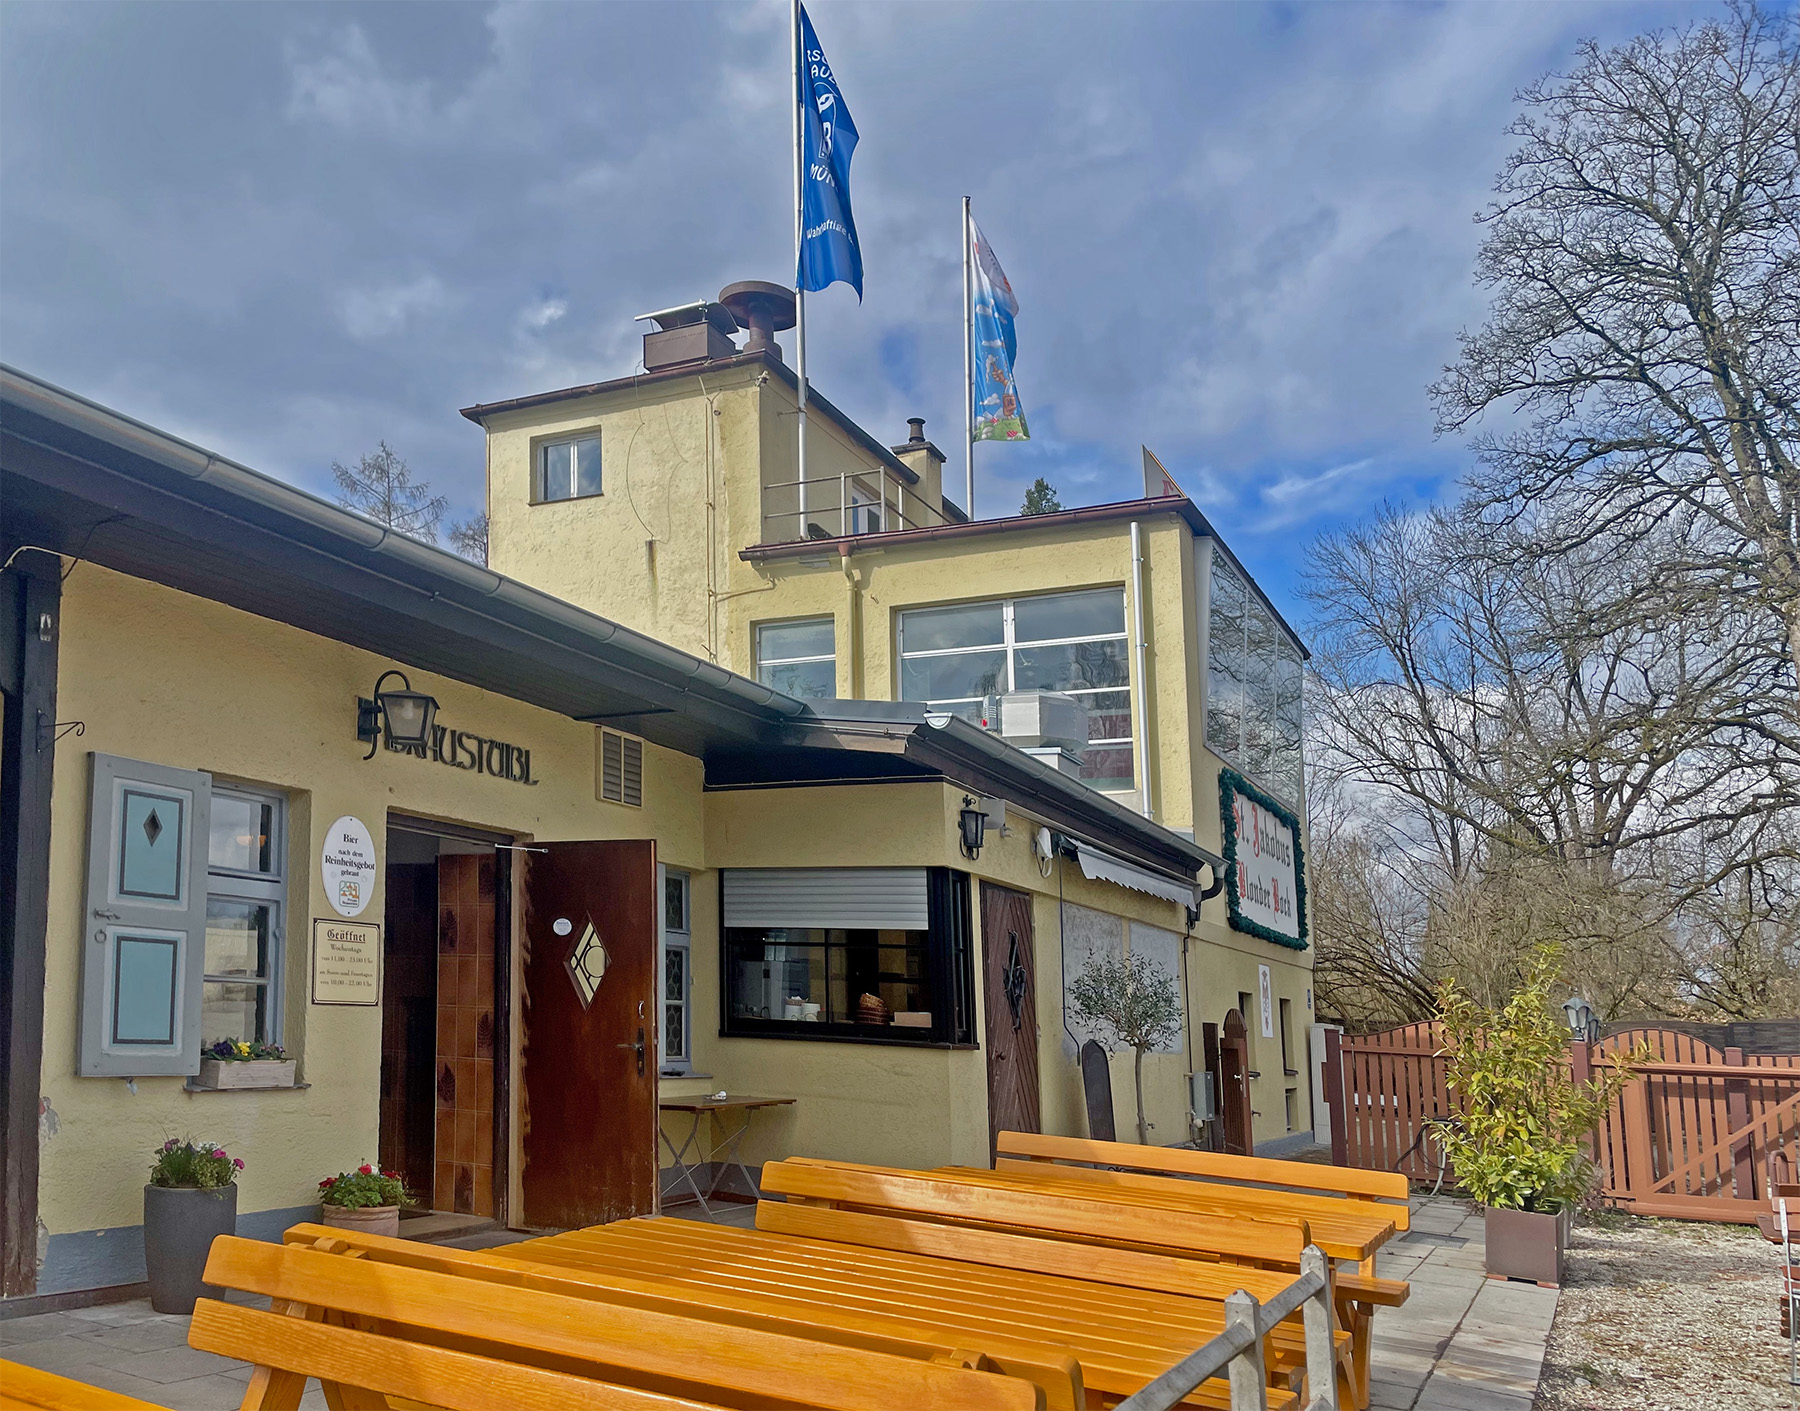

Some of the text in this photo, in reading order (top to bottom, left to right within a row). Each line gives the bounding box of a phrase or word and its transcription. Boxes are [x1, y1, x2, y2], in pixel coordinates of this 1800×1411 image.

[343, 833, 359, 844] Bier
[1251, 803, 1291, 868] Jakobus
[352, 850, 363, 858] dem
[325, 855, 375, 871] Reinheitsgebot
[1236, 859, 1271, 911] Blonder
[327, 928, 366, 942] Geöffnet
[330, 943, 362, 954] Wochentags
